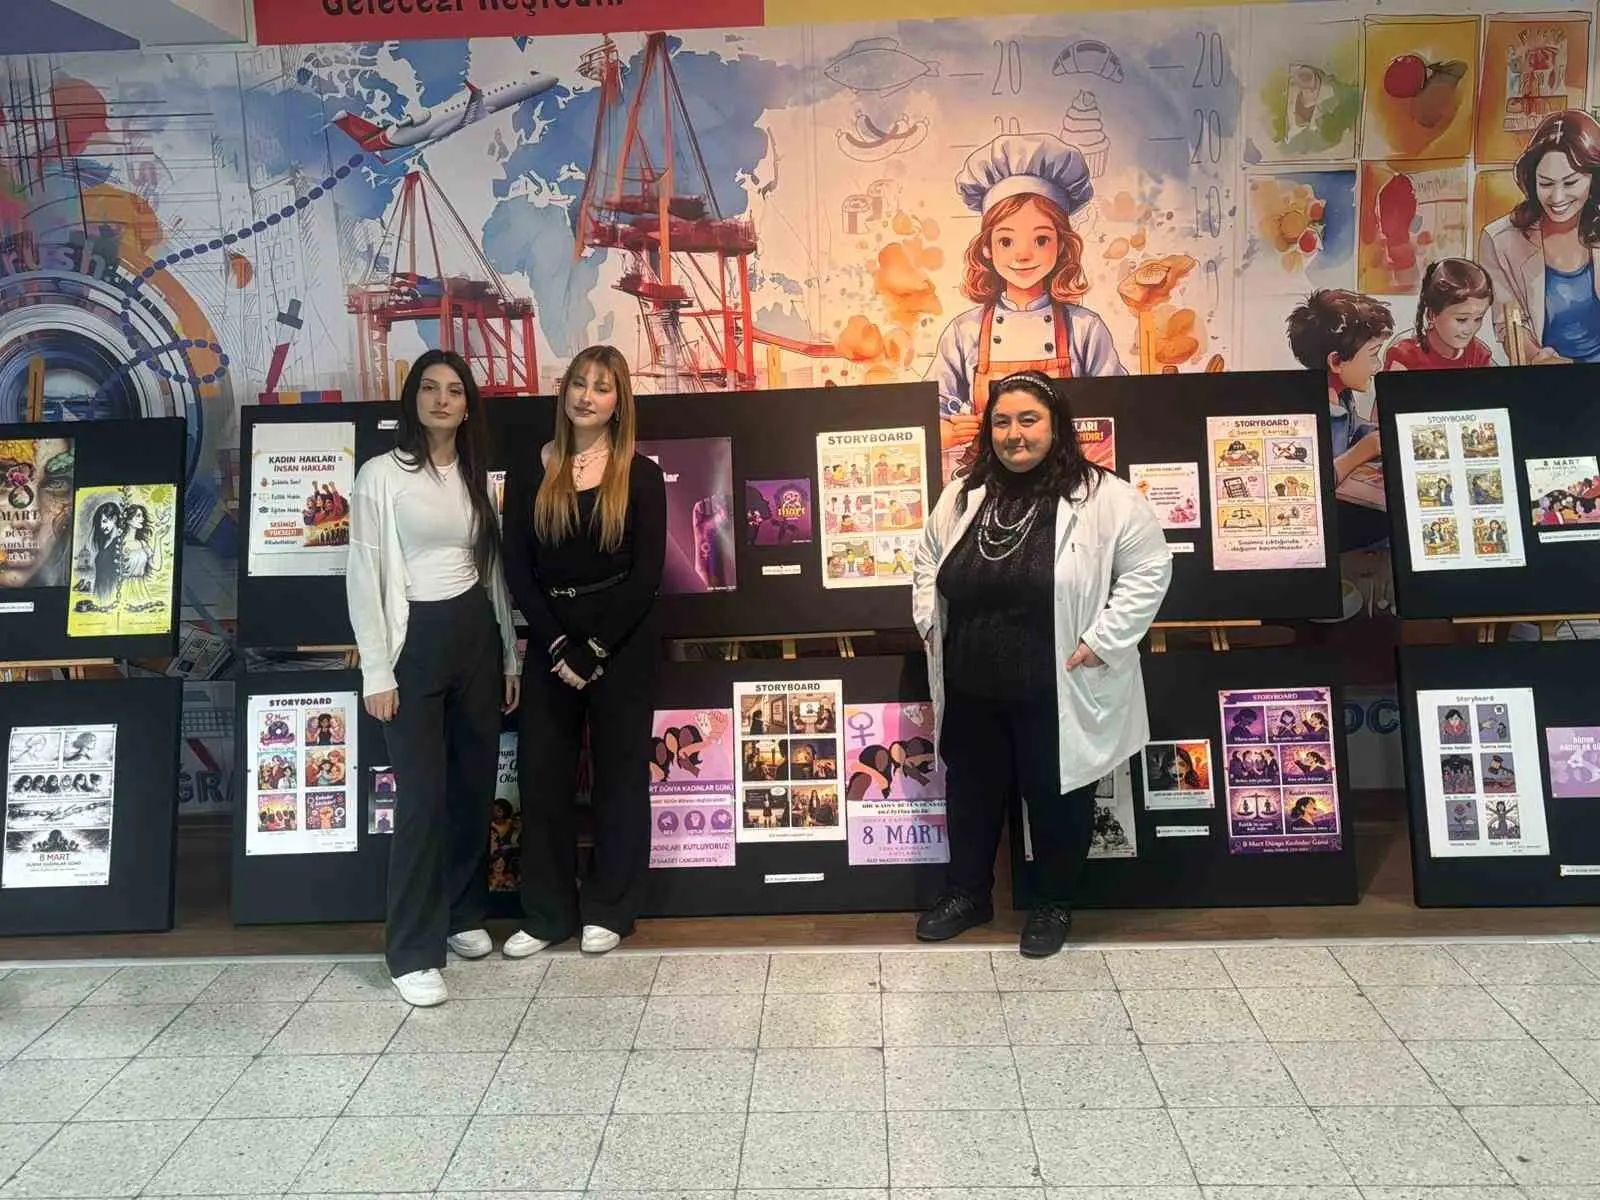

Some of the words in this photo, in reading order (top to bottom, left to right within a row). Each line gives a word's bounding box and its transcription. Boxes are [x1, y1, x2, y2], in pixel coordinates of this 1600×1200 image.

[1192, 32, 1224, 88] 20
[992, 40, 1022, 96] 20
[1190, 109, 1222, 164] 20
[1193, 185, 1222, 239] 10
[1234, 419, 1290, 428] STORYBOARD
[1427, 414, 1477, 424] STORYBOARD
[827, 432, 913, 445] STORYBOARD
[269, 456, 296, 464] KADIN
[273, 464, 299, 473] İNSAN
[301, 464, 335, 472] HAKLARI
[755, 682, 821, 692] STORYBOARD
[269, 697, 332, 707] STORYBOARD
[1252, 693, 1298, 702] STORYBOARD
[862, 825, 874, 845] 8
[885, 824, 945, 844] MART
[47, 853, 70, 861] MART
